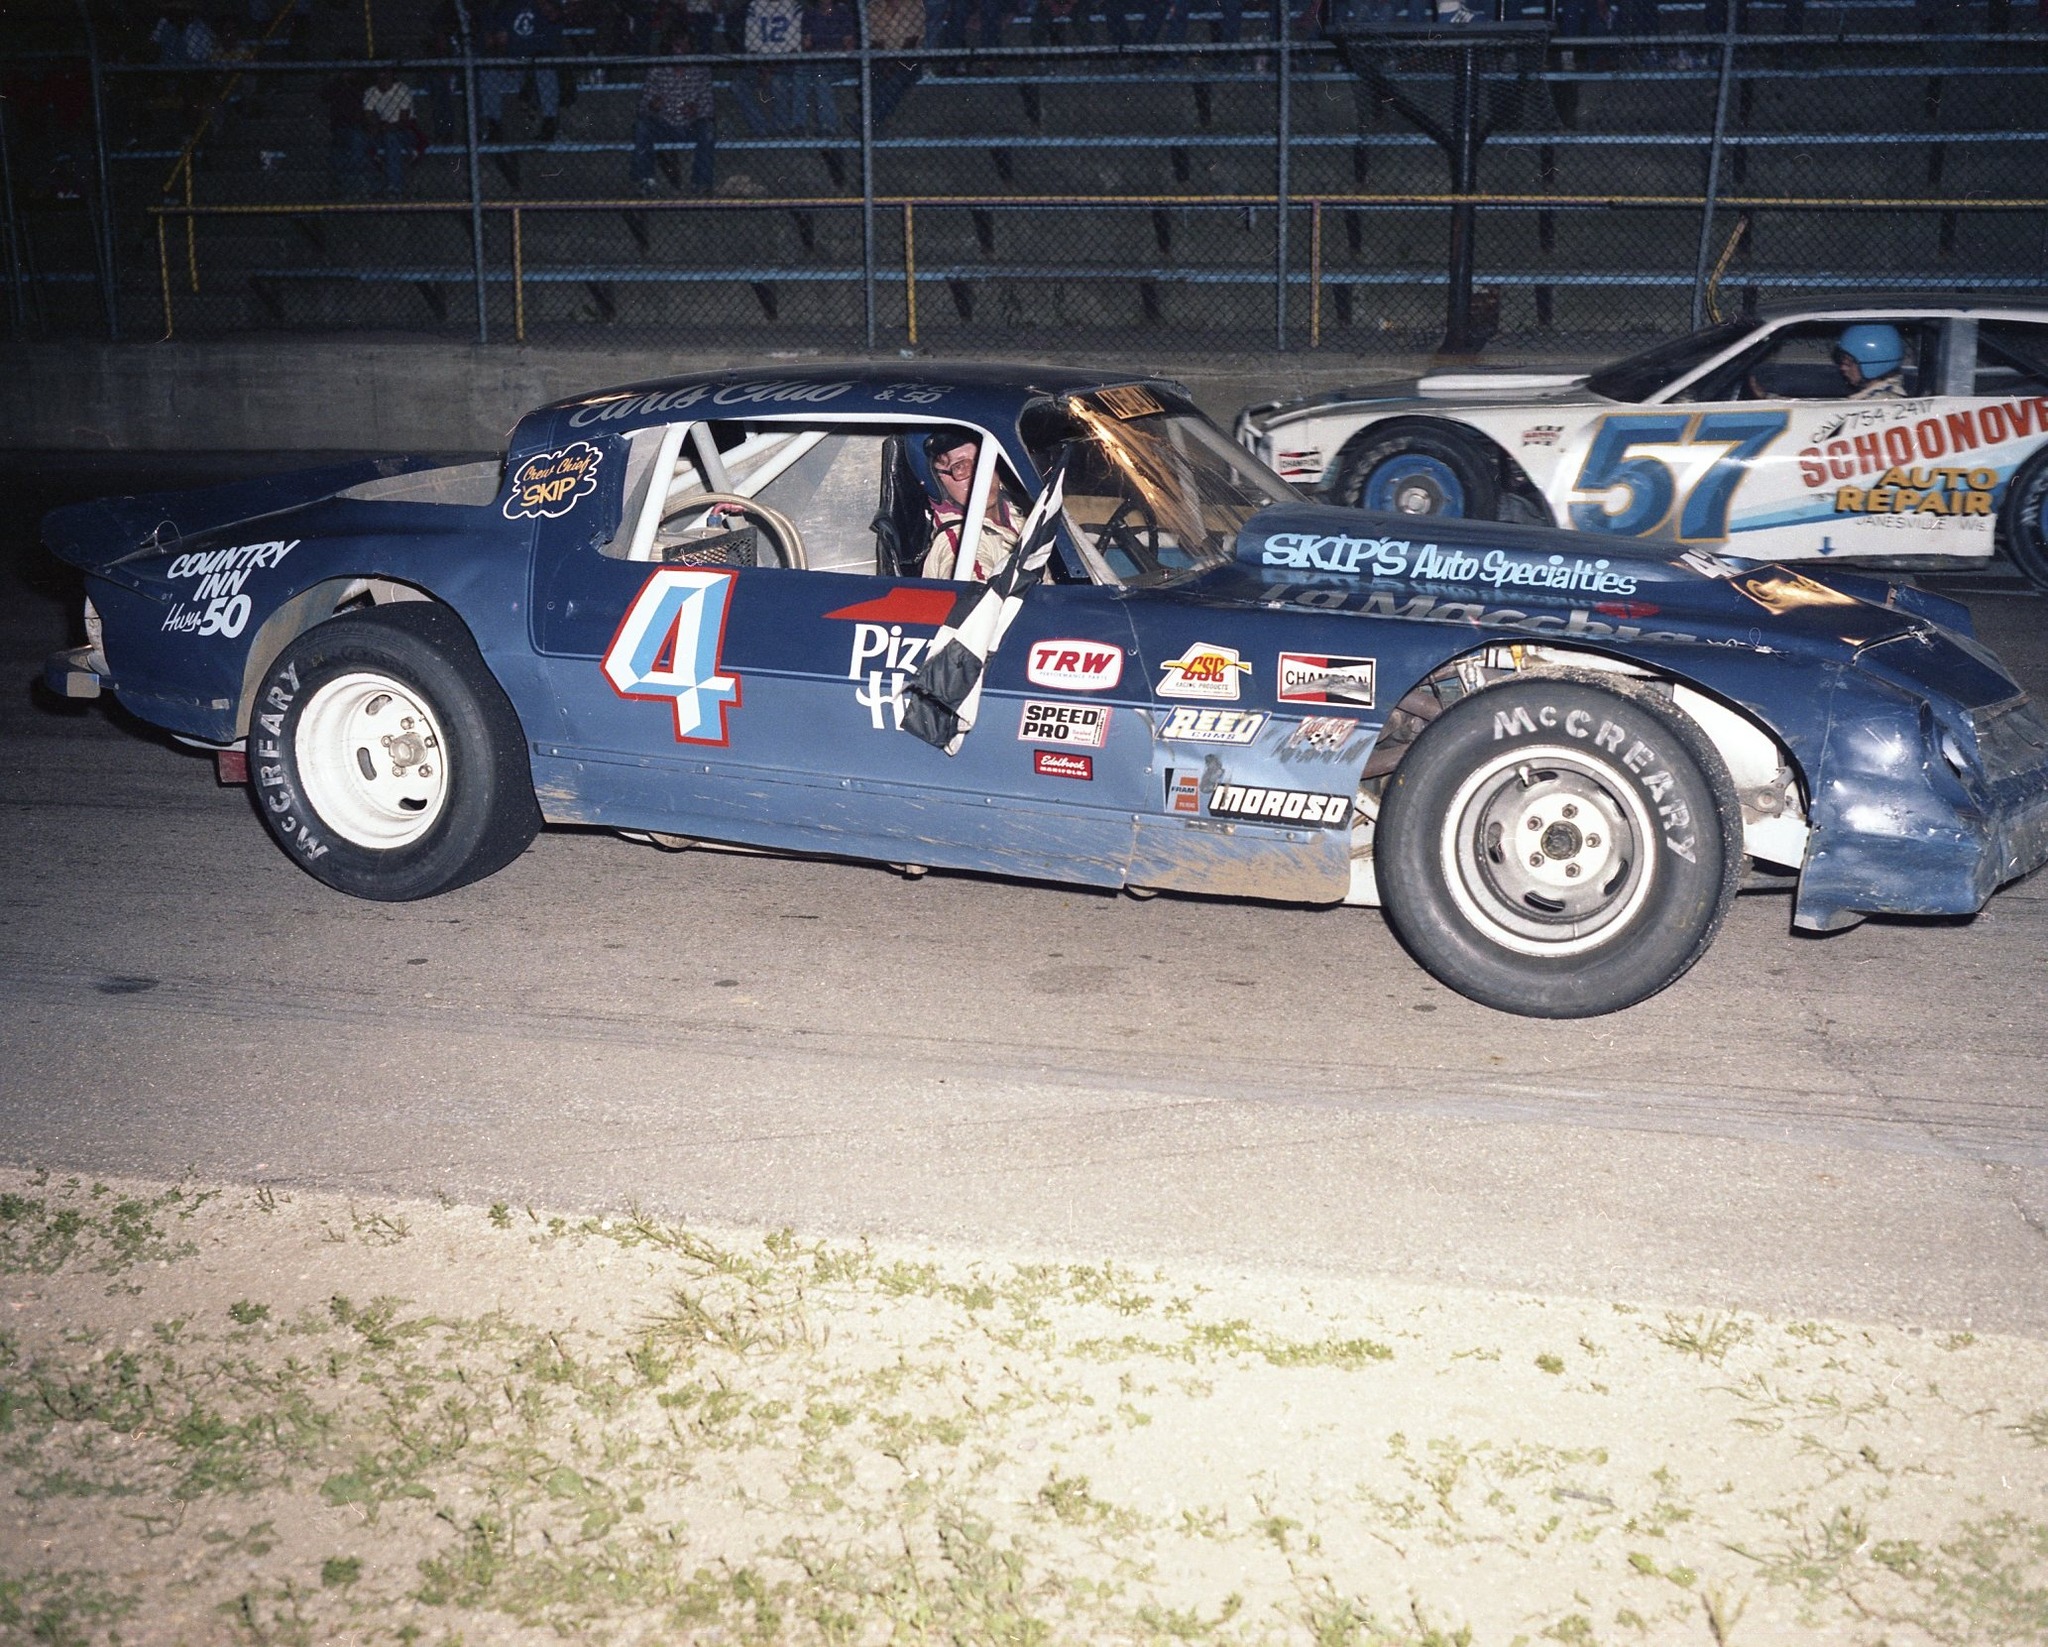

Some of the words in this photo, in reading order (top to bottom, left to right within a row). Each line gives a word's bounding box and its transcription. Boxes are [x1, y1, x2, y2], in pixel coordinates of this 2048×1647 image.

[758, 15, 791, 44] 12
[874, 389, 895, 401] &
[897, 390, 943, 404] 50
[523, 464, 556, 481] Crew
[556, 452, 593, 474] Chief
[1568, 408, 1792, 543] 57
[1873, 465, 2000, 490] AUTO
[1834, 485, 1995, 517] REPAIR
[166, 539, 301, 579] COUNTRY
[1262, 532, 1411, 577] SKIP'S
[1410, 543, 1480, 581] Auto
[1479, 548, 1639, 596] Specialties
[192, 568, 252, 602] INN
[197, 593, 252, 639] 50
[600, 565, 743, 747] 4
[1035, 649, 1115, 675] TRW
[1026, 705, 1099, 726] SPEED
[1163, 707, 1264, 741] REED
[1022, 722, 1070, 740] PRO
[1191, 732, 1236, 740] CAMS
[1040, 755, 1086, 770] Edelbrock
[1170, 785, 1195, 794] FRAM
